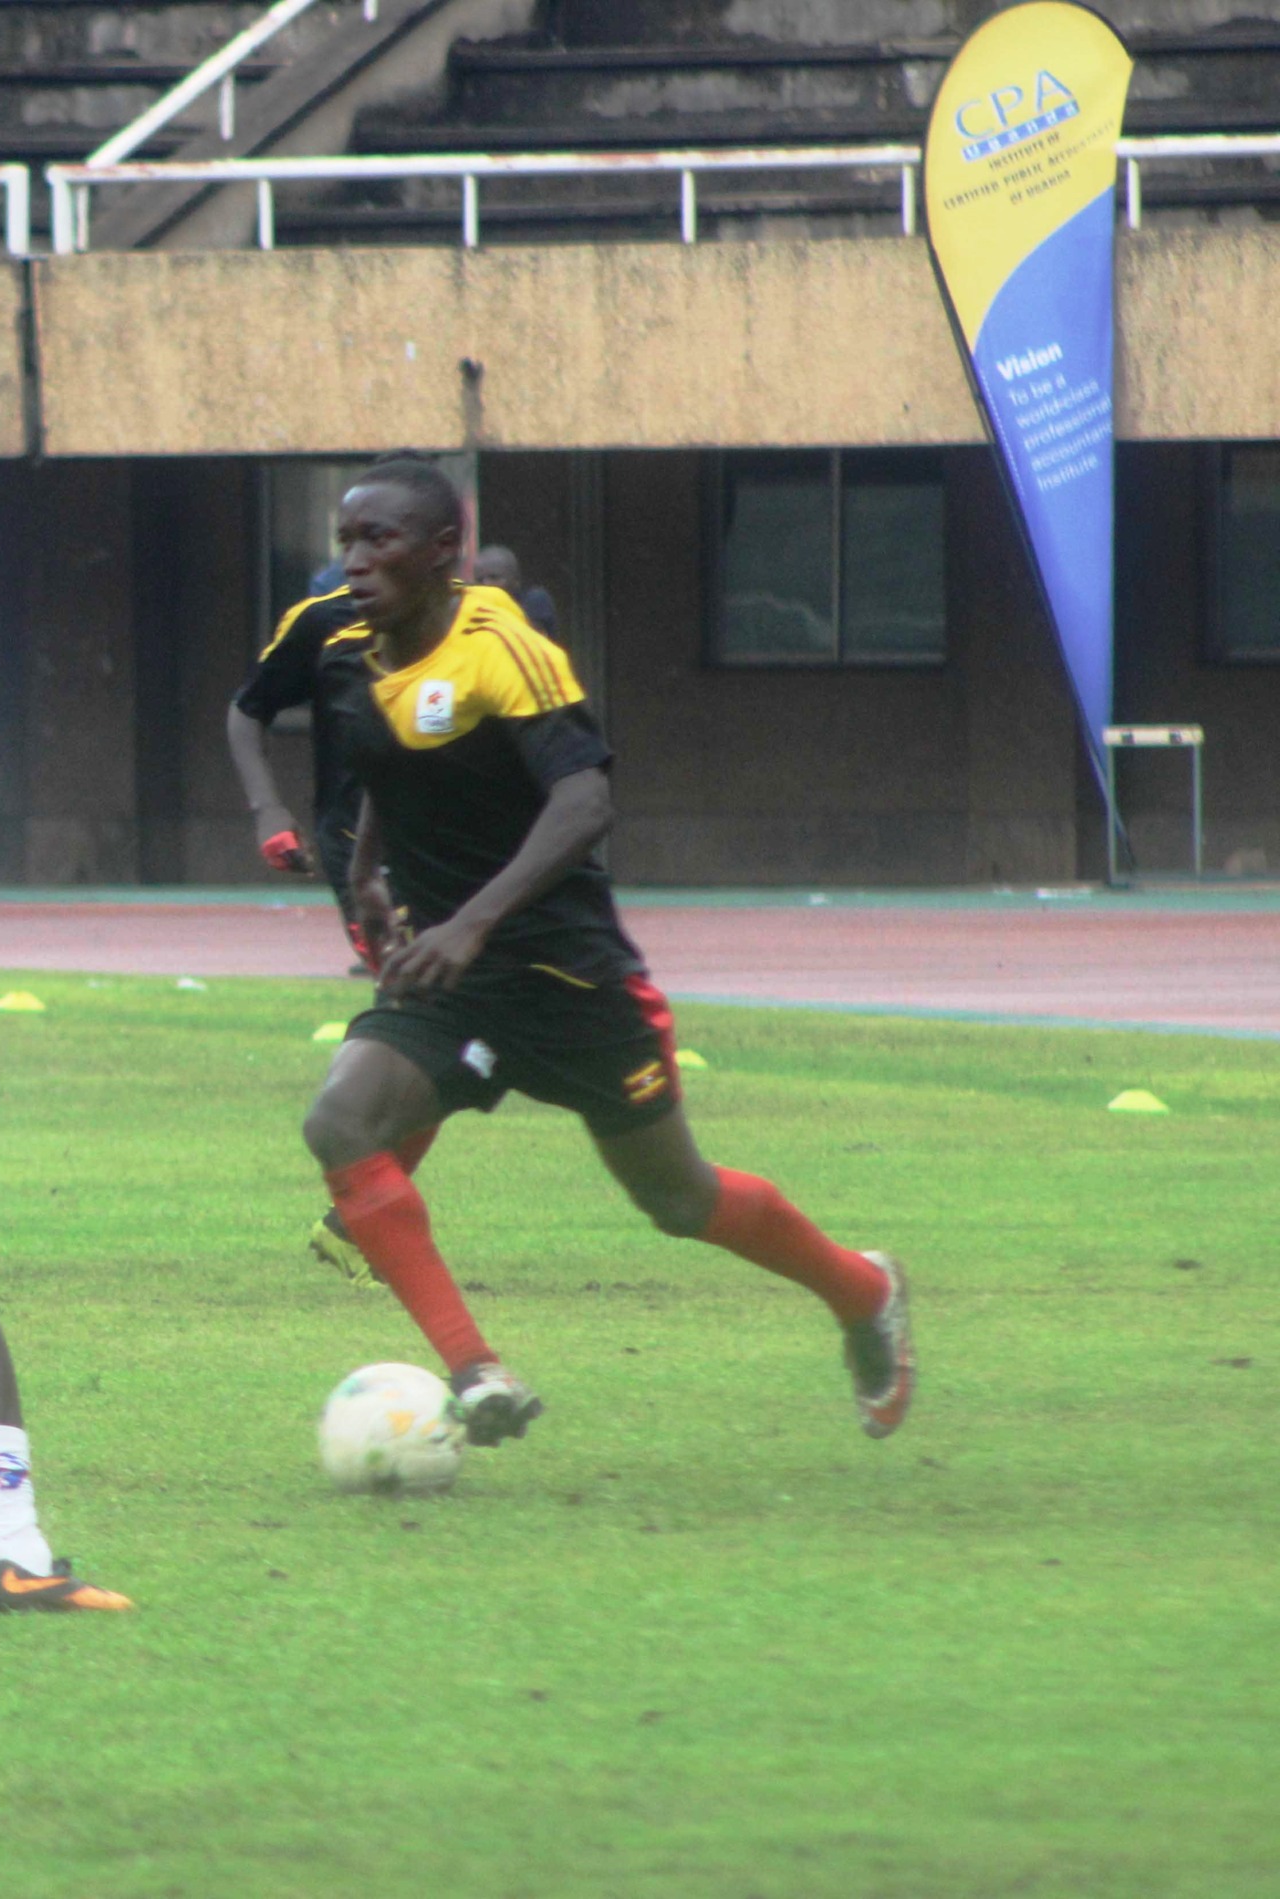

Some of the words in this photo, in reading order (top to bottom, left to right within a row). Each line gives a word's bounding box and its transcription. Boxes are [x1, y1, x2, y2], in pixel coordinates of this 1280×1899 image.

[955, 69, 1074, 139] CPA
[989, 141, 1044, 171] INSTITUTE
[1047, 131, 1061, 147] OF
[943, 181, 1000, 211] CERTIFIED
[1003, 164, 1044, 188] PUBLIC
[1009, 189, 1023, 206] OF
[1026, 169, 1072, 198] UGANDA
[996, 342, 1063, 381] Vision
[1015, 377, 1099, 429] world-class
[1030, 379, 1054, 400] be
[1056, 373, 1066, 389] a
[1024, 391, 1112, 453] professional
